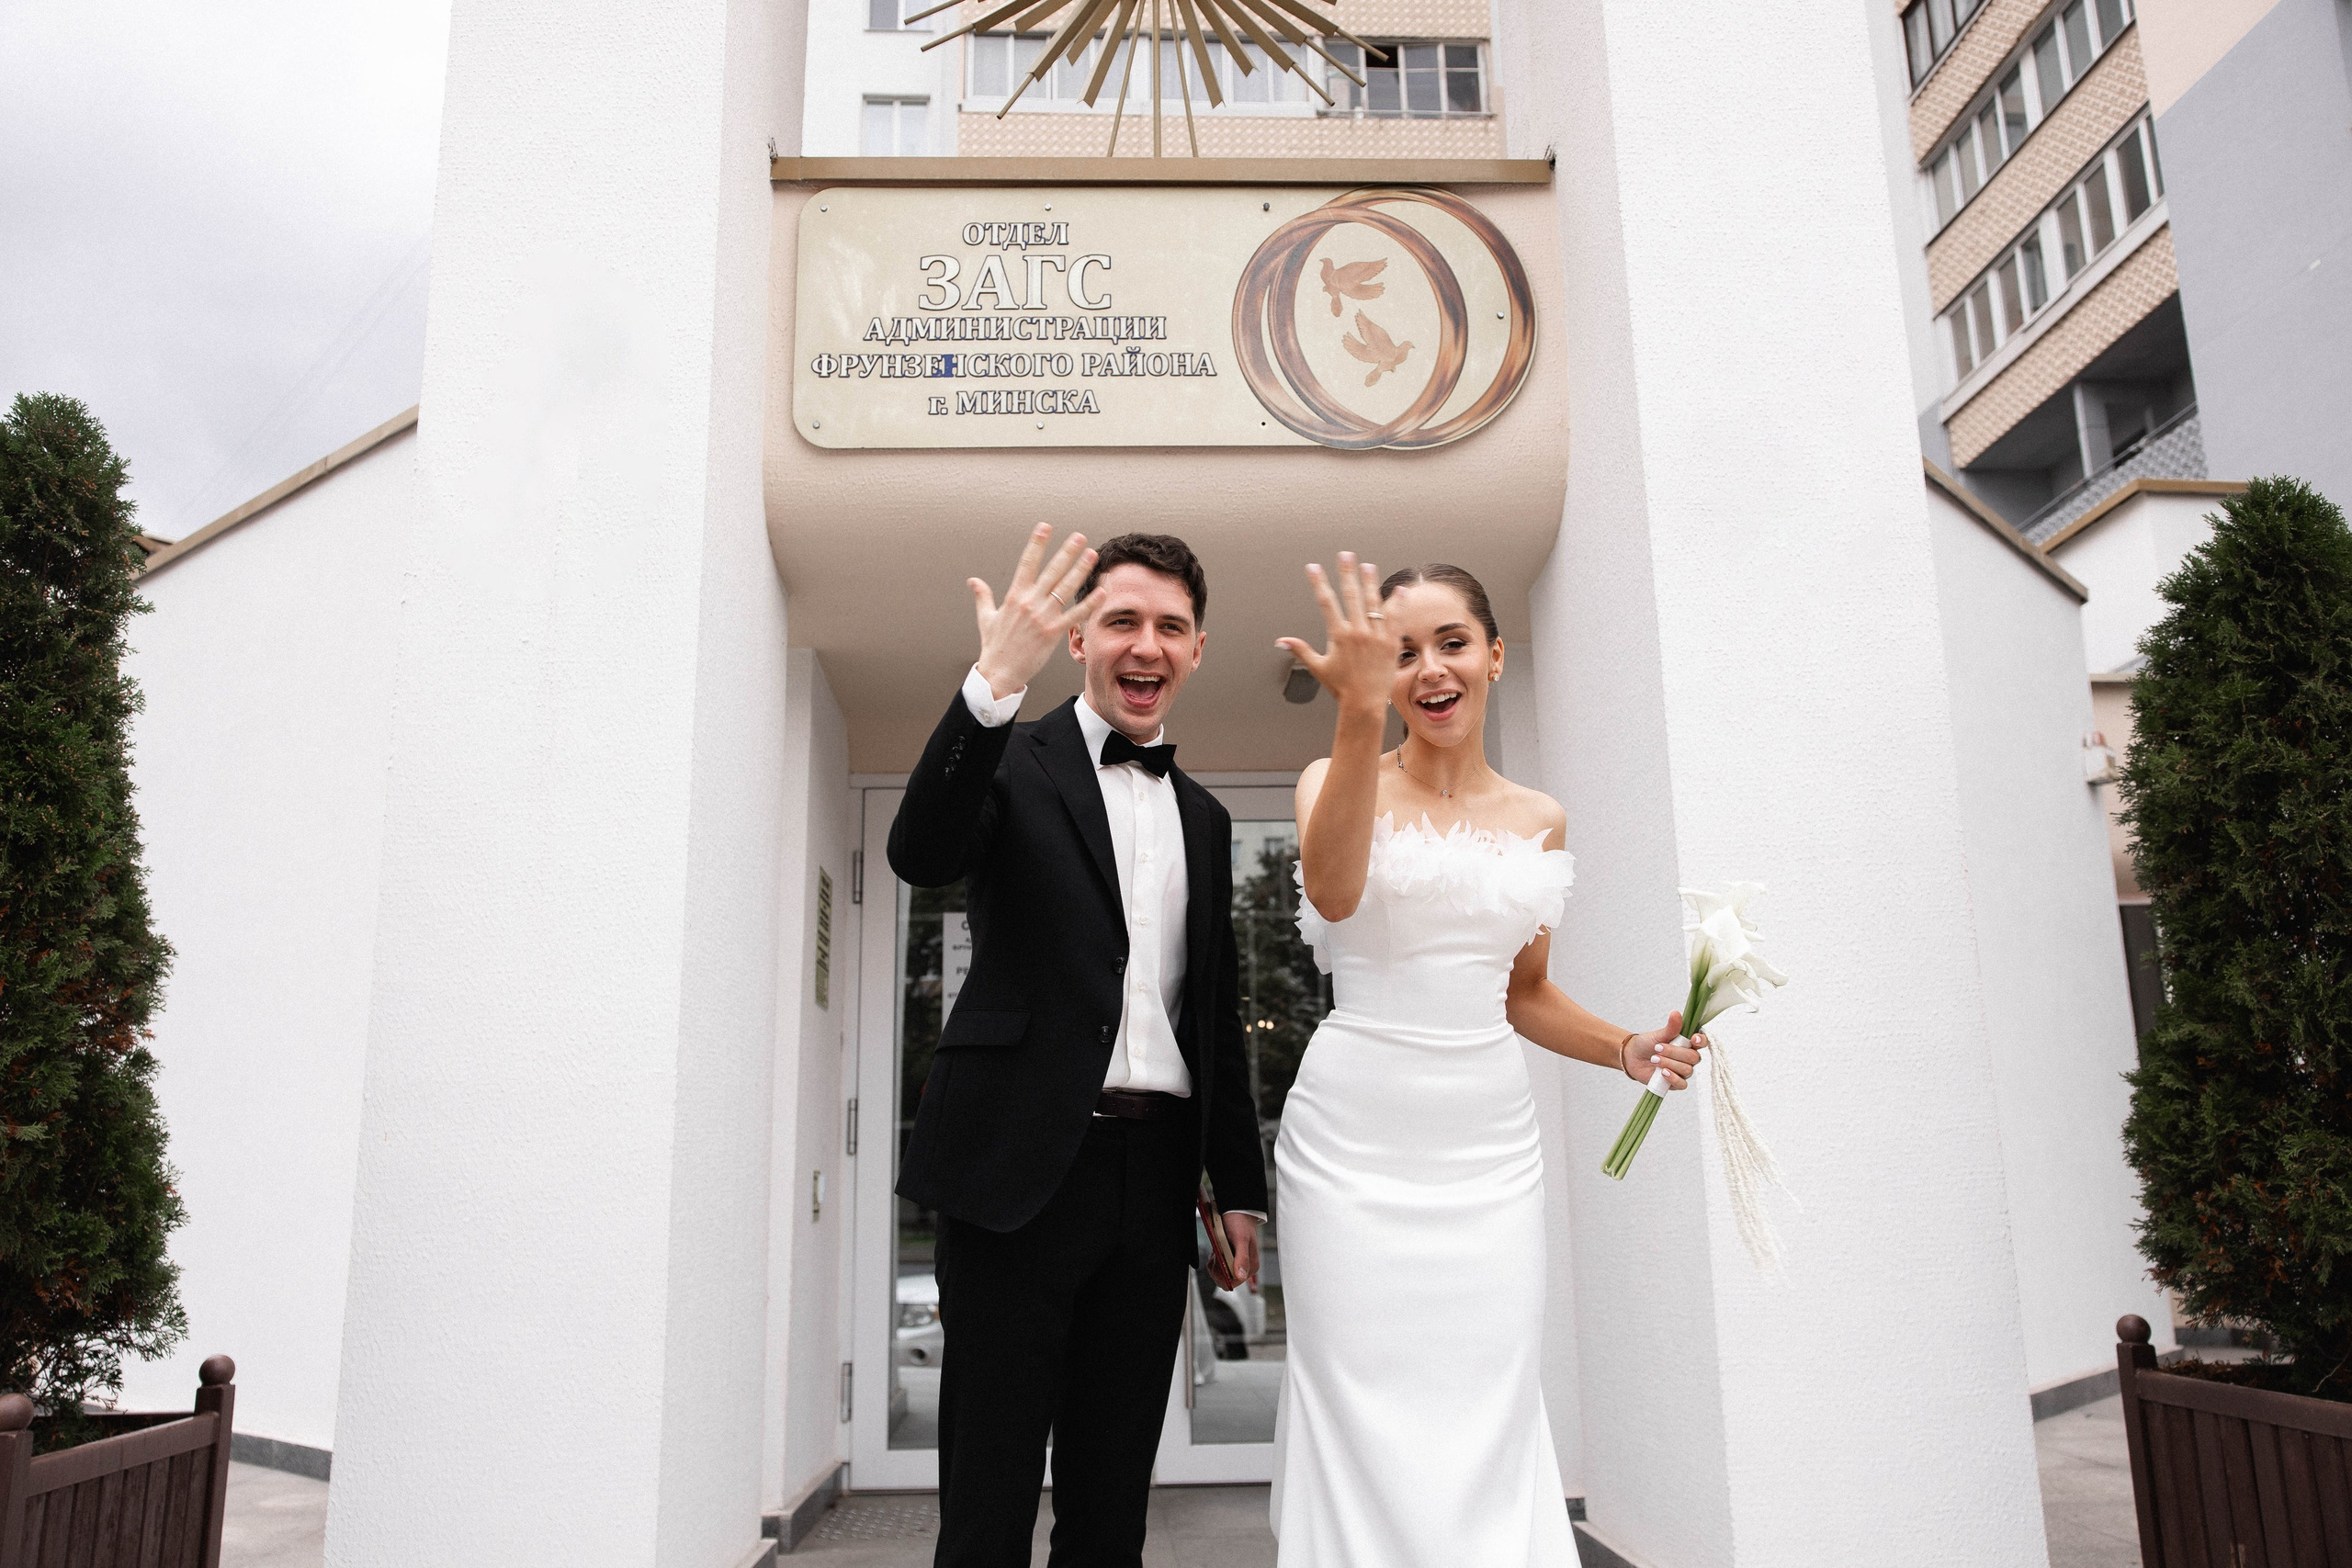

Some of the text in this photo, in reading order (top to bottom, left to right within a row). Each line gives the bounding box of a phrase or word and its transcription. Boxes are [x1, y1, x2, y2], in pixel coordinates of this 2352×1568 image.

[962, 221, 1069, 251] ОТДЕЛ
[918, 254, 1113, 311] ЗАГС
[863, 316, 1168, 346] АДМИНИСТРАЦИИ
[810, 345, 1217, 378] ФРУНЗЕНСКОГО РАЙОНА
[928, 389, 1101, 416] г. МИНСКА
